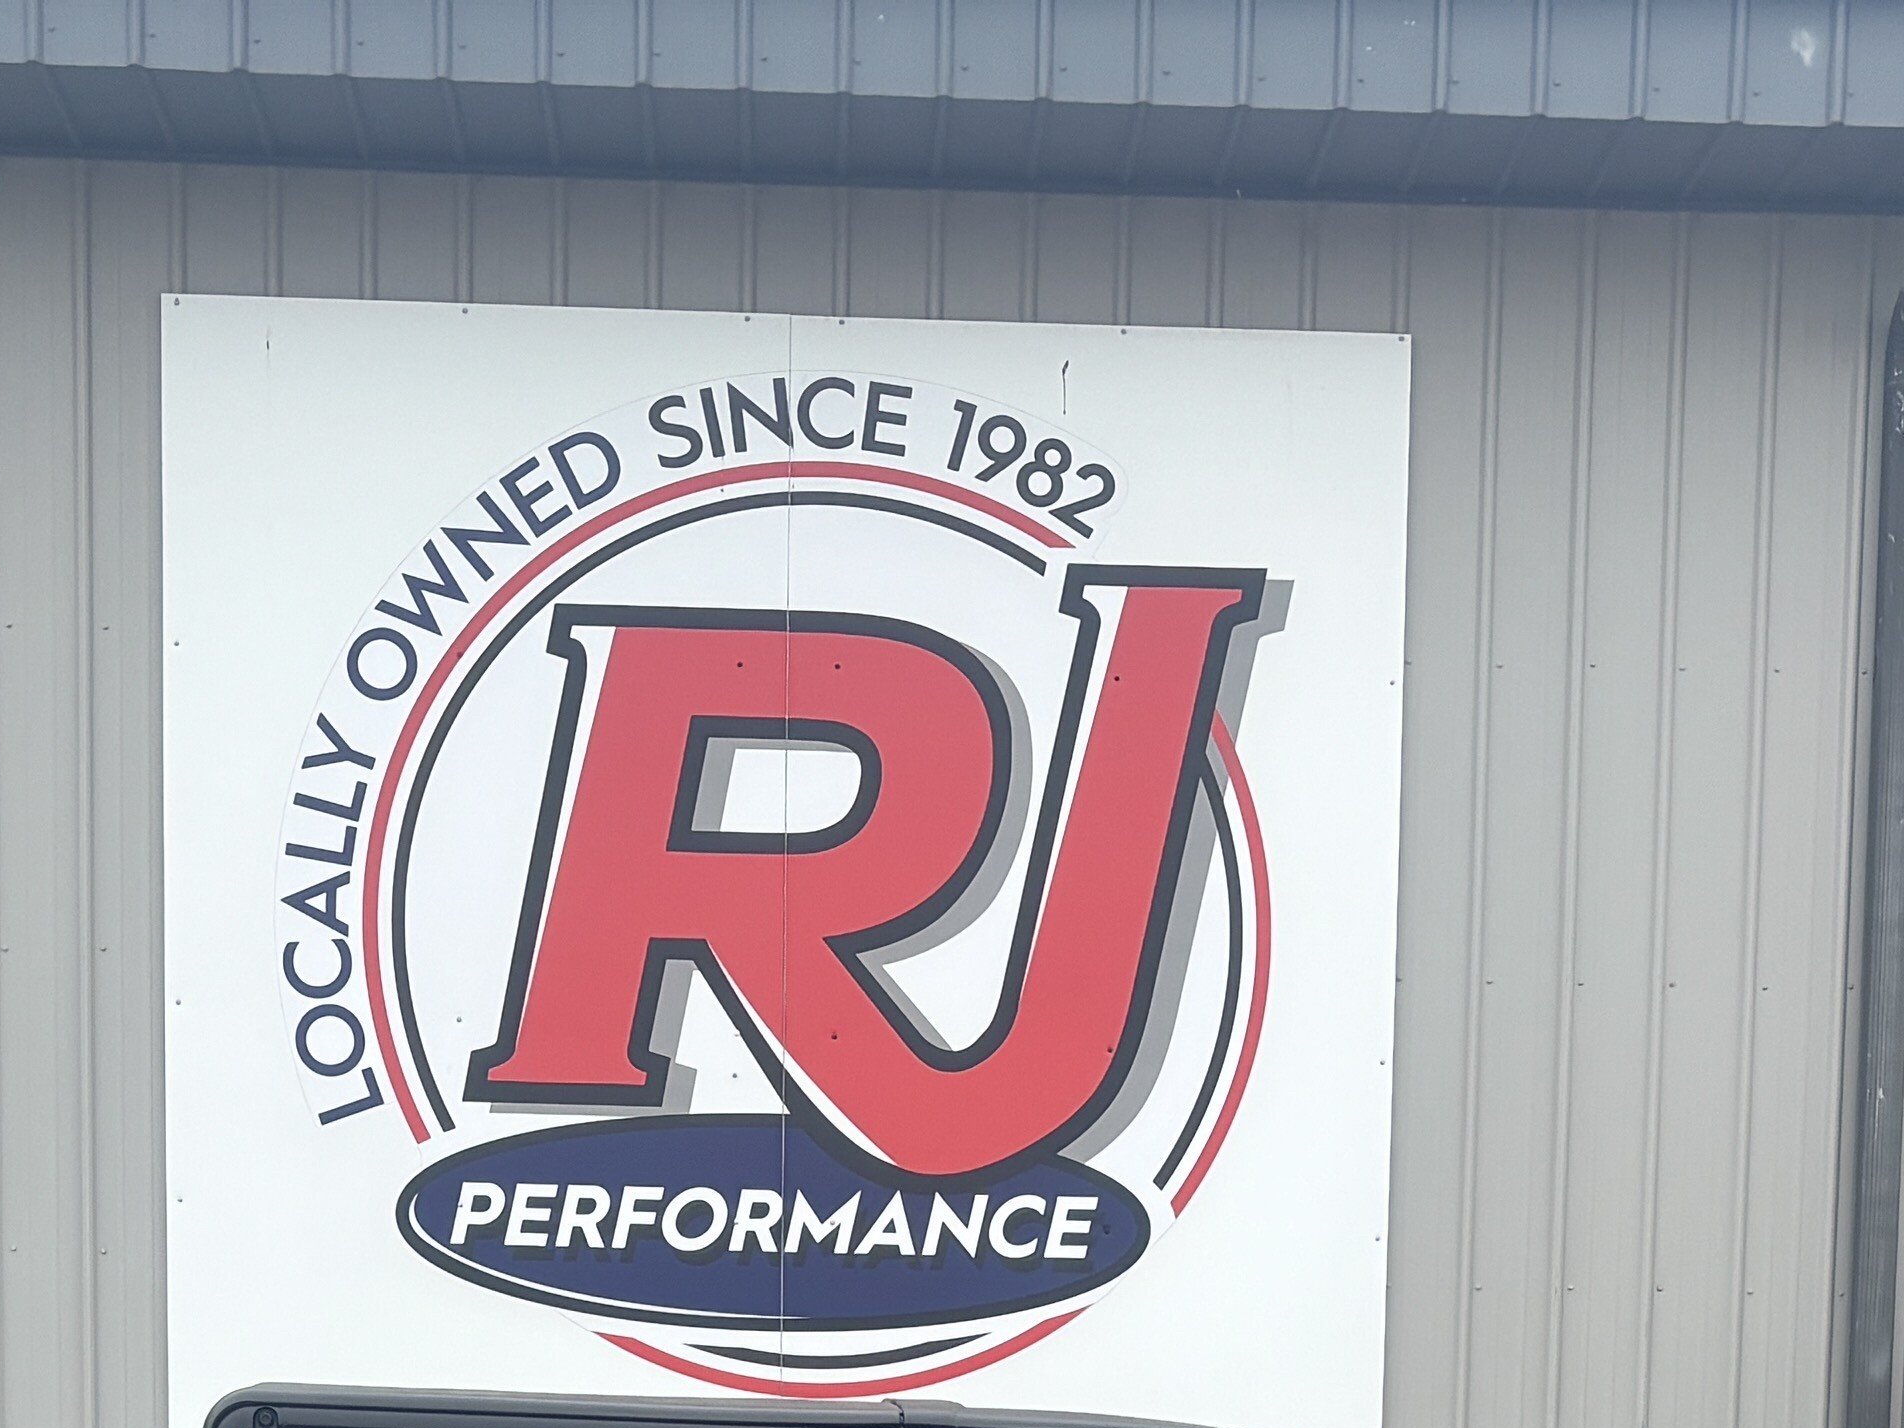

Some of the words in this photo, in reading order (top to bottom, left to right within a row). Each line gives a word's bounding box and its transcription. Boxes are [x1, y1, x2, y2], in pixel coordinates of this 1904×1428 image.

[280, 712, 384, 1126] LOCALLY
[347, 431, 620, 701] OWNED
[648, 376, 913, 468] SINCE
[947, 400, 1116, 539] 1982
[463, 564, 1268, 1190] RJ
[450, 1181, 1099, 1260] PERFORMANCE
